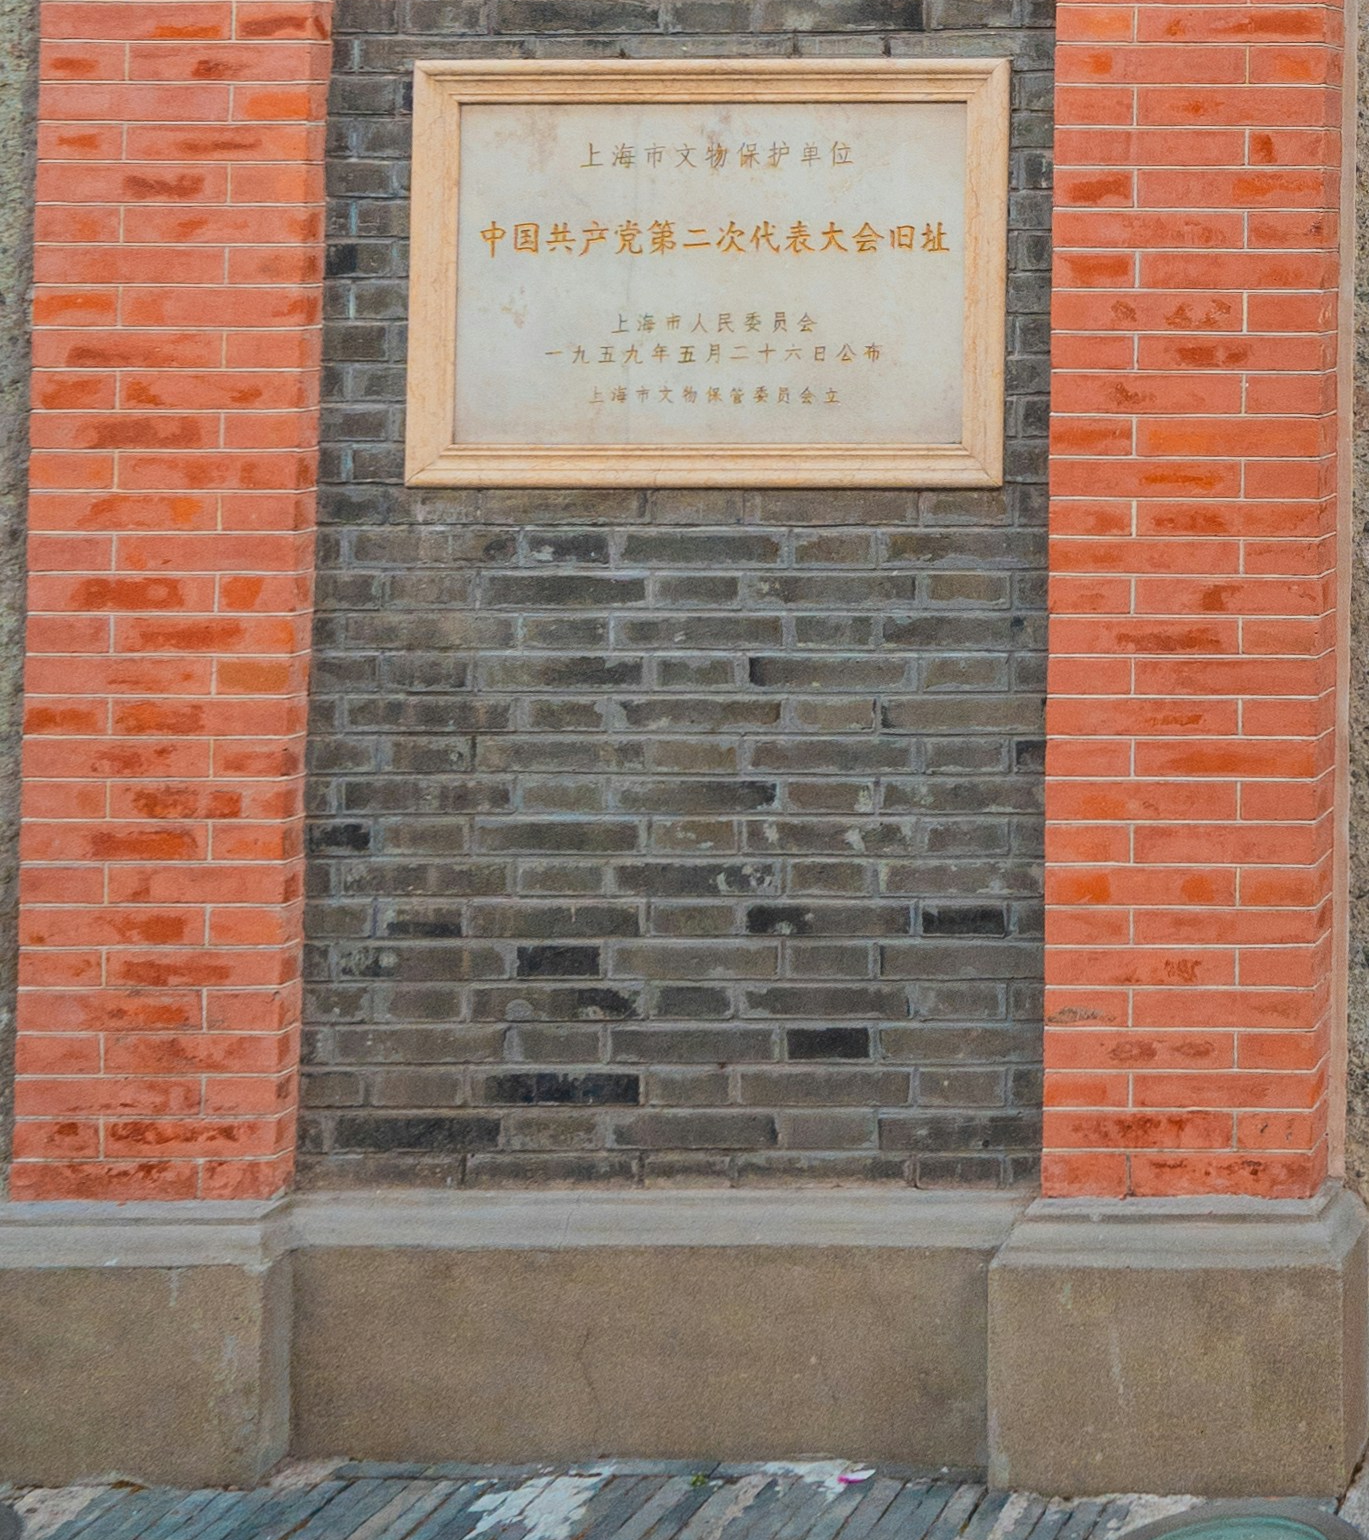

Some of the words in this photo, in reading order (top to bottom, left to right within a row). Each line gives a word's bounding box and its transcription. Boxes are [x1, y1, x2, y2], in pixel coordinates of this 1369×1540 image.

[580, 140, 855, 169] 上海市文物保护单位
[480, 220, 951, 257] 中国共产党第二次代表大会旧址
[611, 311, 818, 334] 上海市人民委员会
[545, 342, 882, 364] 一九五九年五月二十六日公布
[589, 386, 842, 405] 上海市文物保管委员会立
